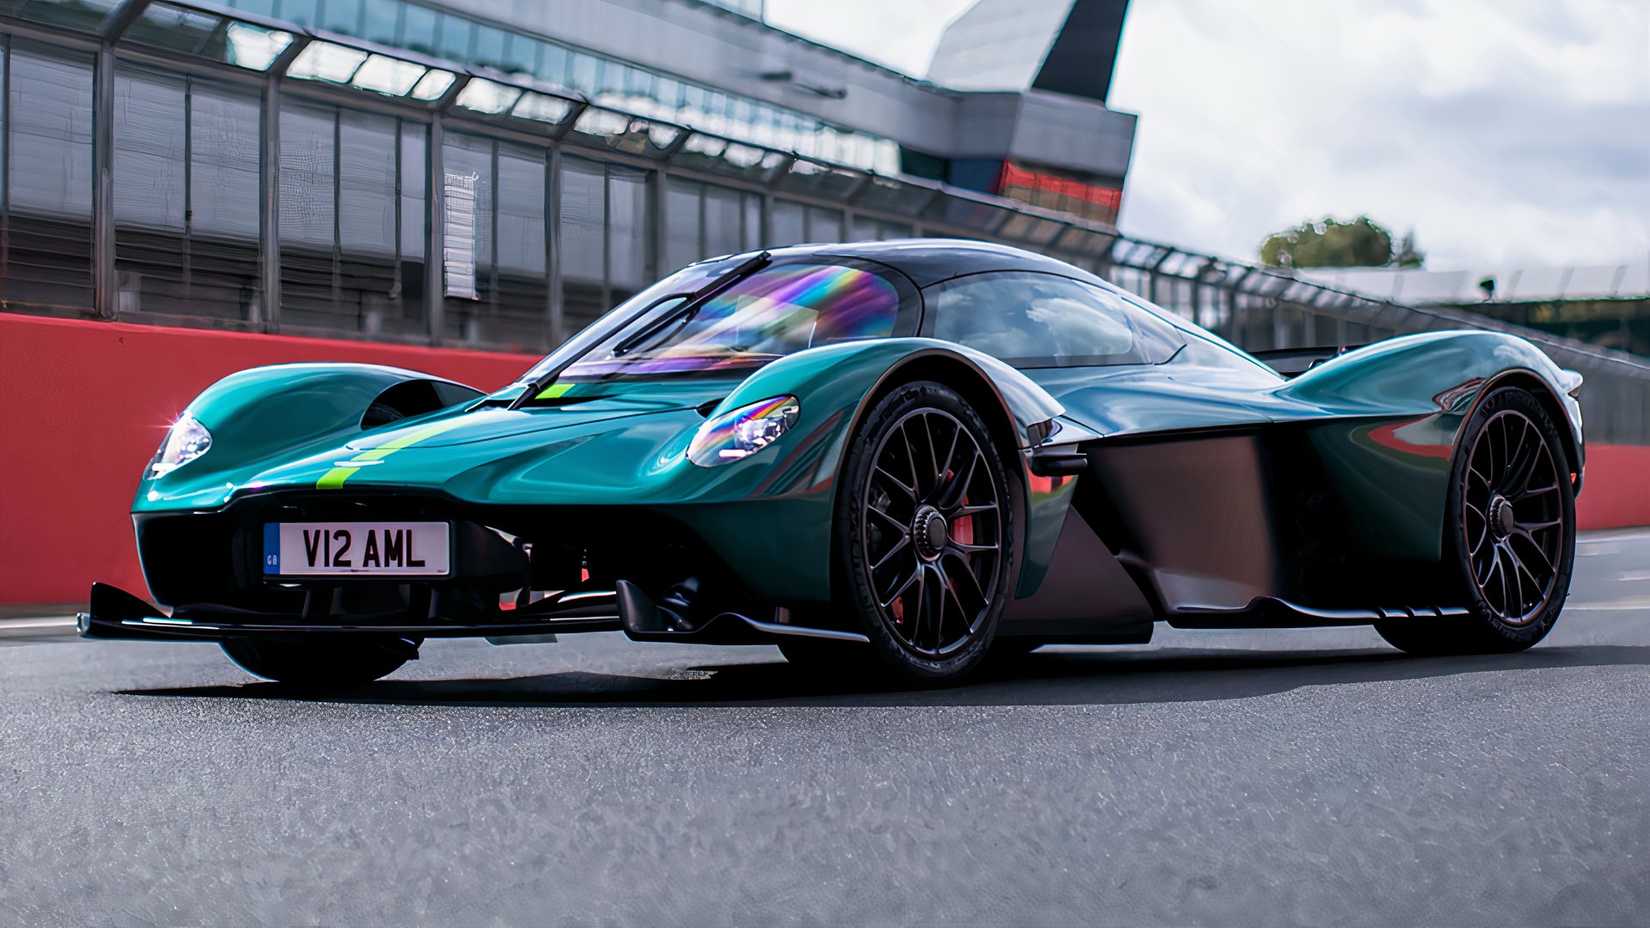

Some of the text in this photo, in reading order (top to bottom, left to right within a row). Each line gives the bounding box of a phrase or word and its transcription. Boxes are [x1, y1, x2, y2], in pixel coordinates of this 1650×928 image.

[266, 554, 278, 566] GB
[303, 529, 426, 567] V12 AML
